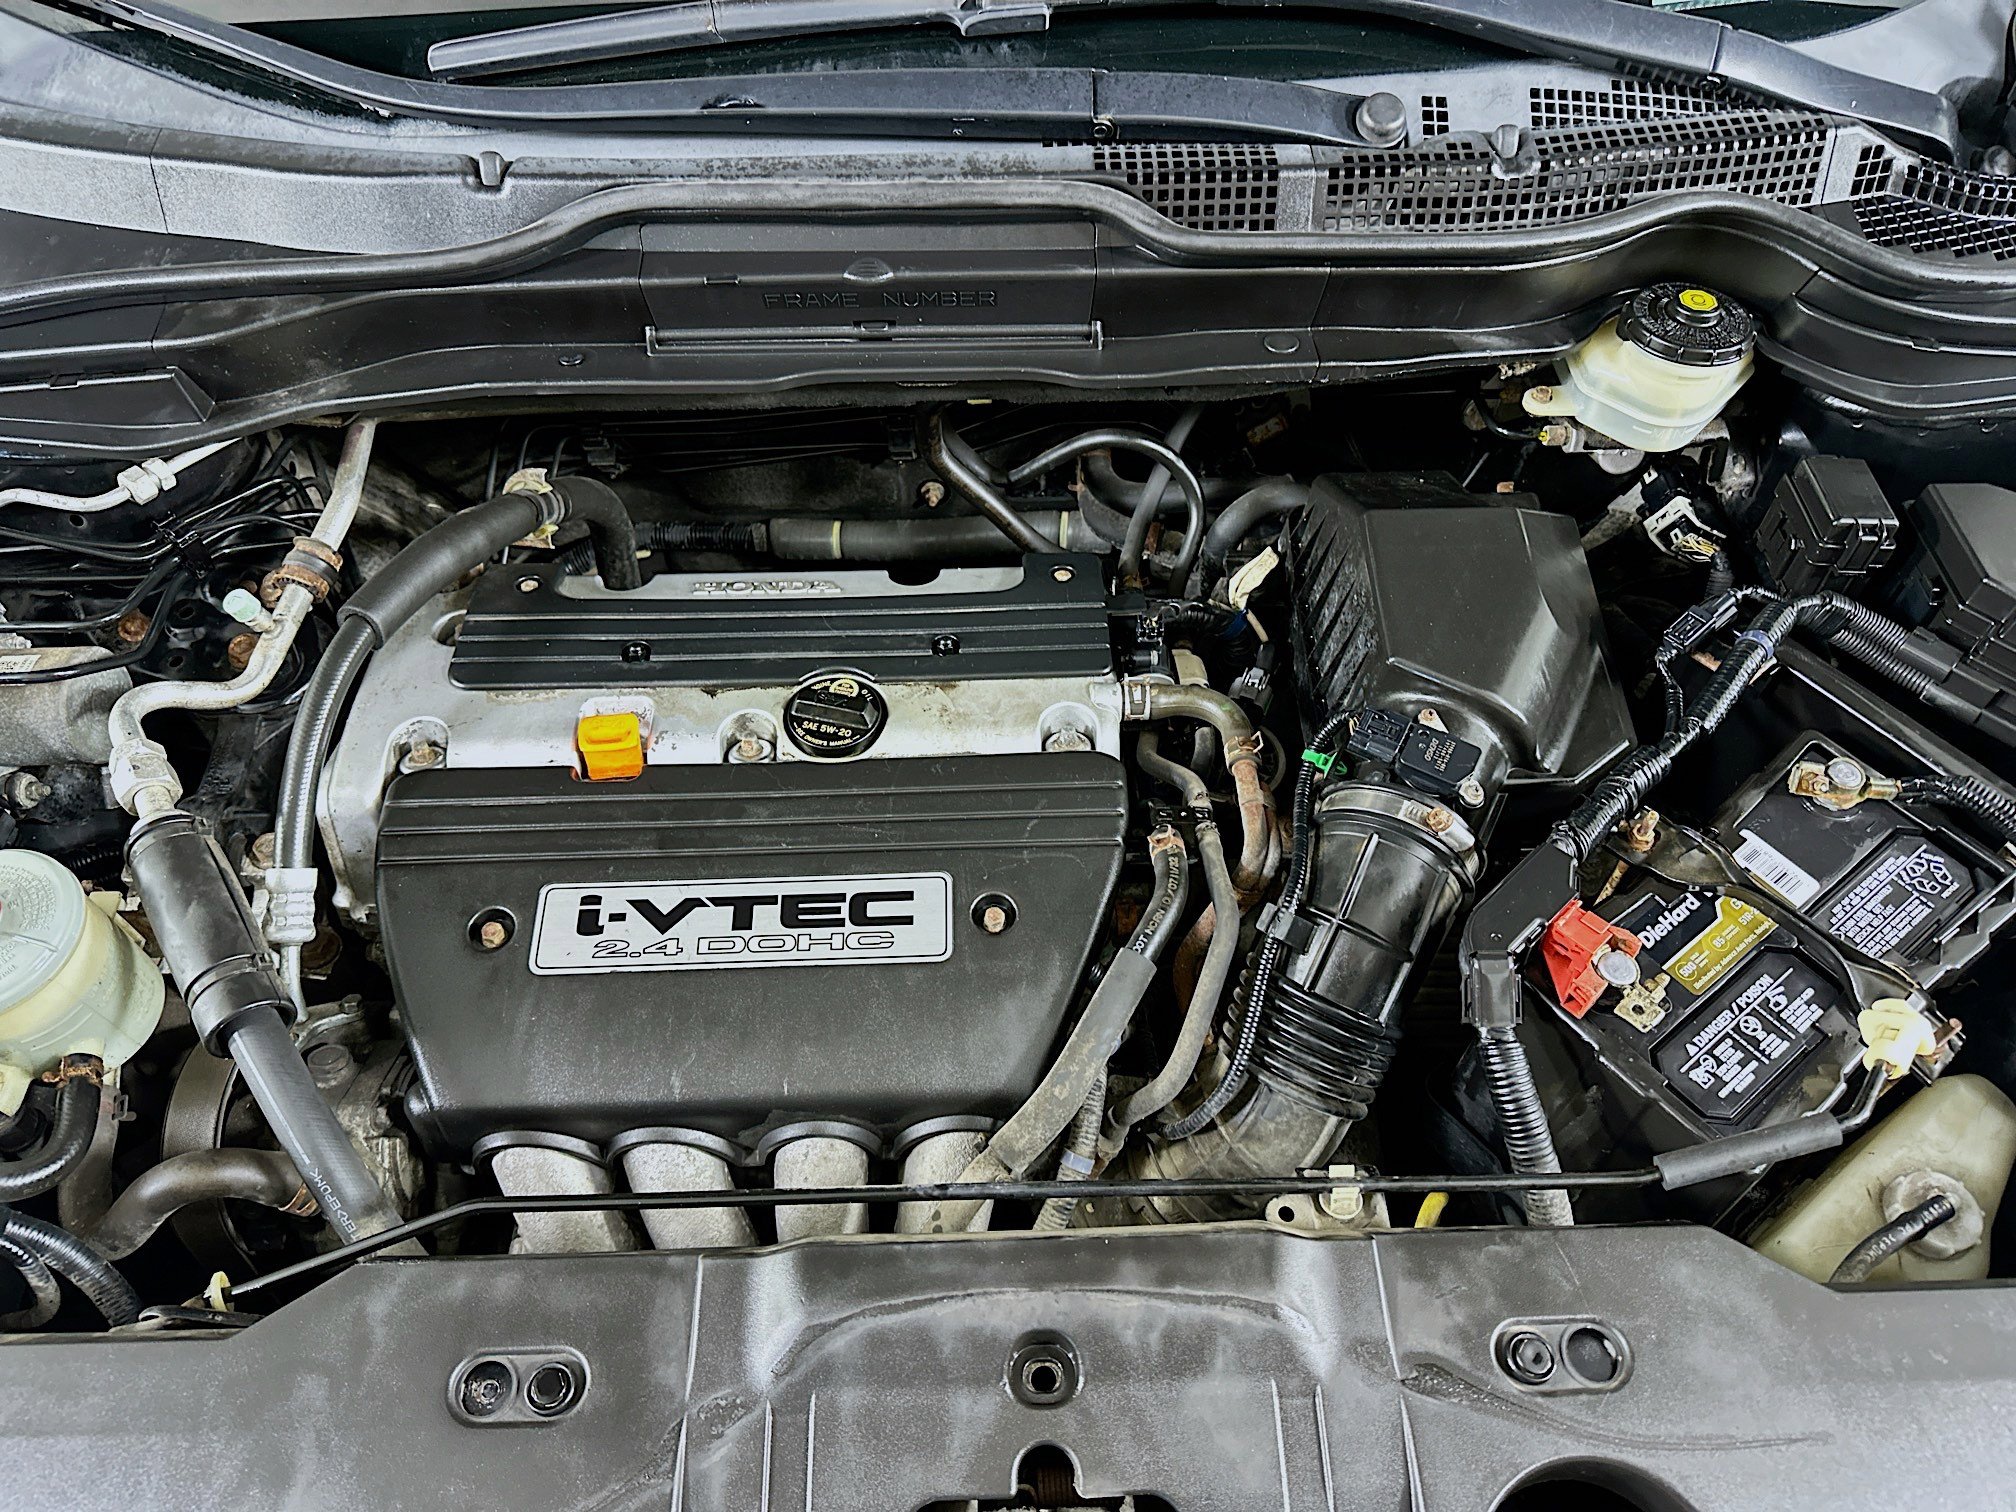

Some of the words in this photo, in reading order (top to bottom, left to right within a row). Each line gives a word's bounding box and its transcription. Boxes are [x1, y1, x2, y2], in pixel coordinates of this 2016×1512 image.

[763, 292, 860, 308] FRAME
[883, 291, 996, 308] NUMBER
[692, 580, 843, 596] HONDA
[861, 689, 874, 702] OIL
[802, 720, 820, 731] SAE
[819, 724, 852, 738] 5W-20
[1424, 737, 1440, 762] DENSO
[576, 890, 916, 936] i-VTEC
[1637, 892, 1702, 950] DieHard
[592, 937, 684, 959] 2.4
[696, 930, 896, 956] DOHC
[1678, 961, 1698, 978] 500
[1692, 1009, 1735, 1049] DANGER
[1736, 973, 1775, 1009] POISON
